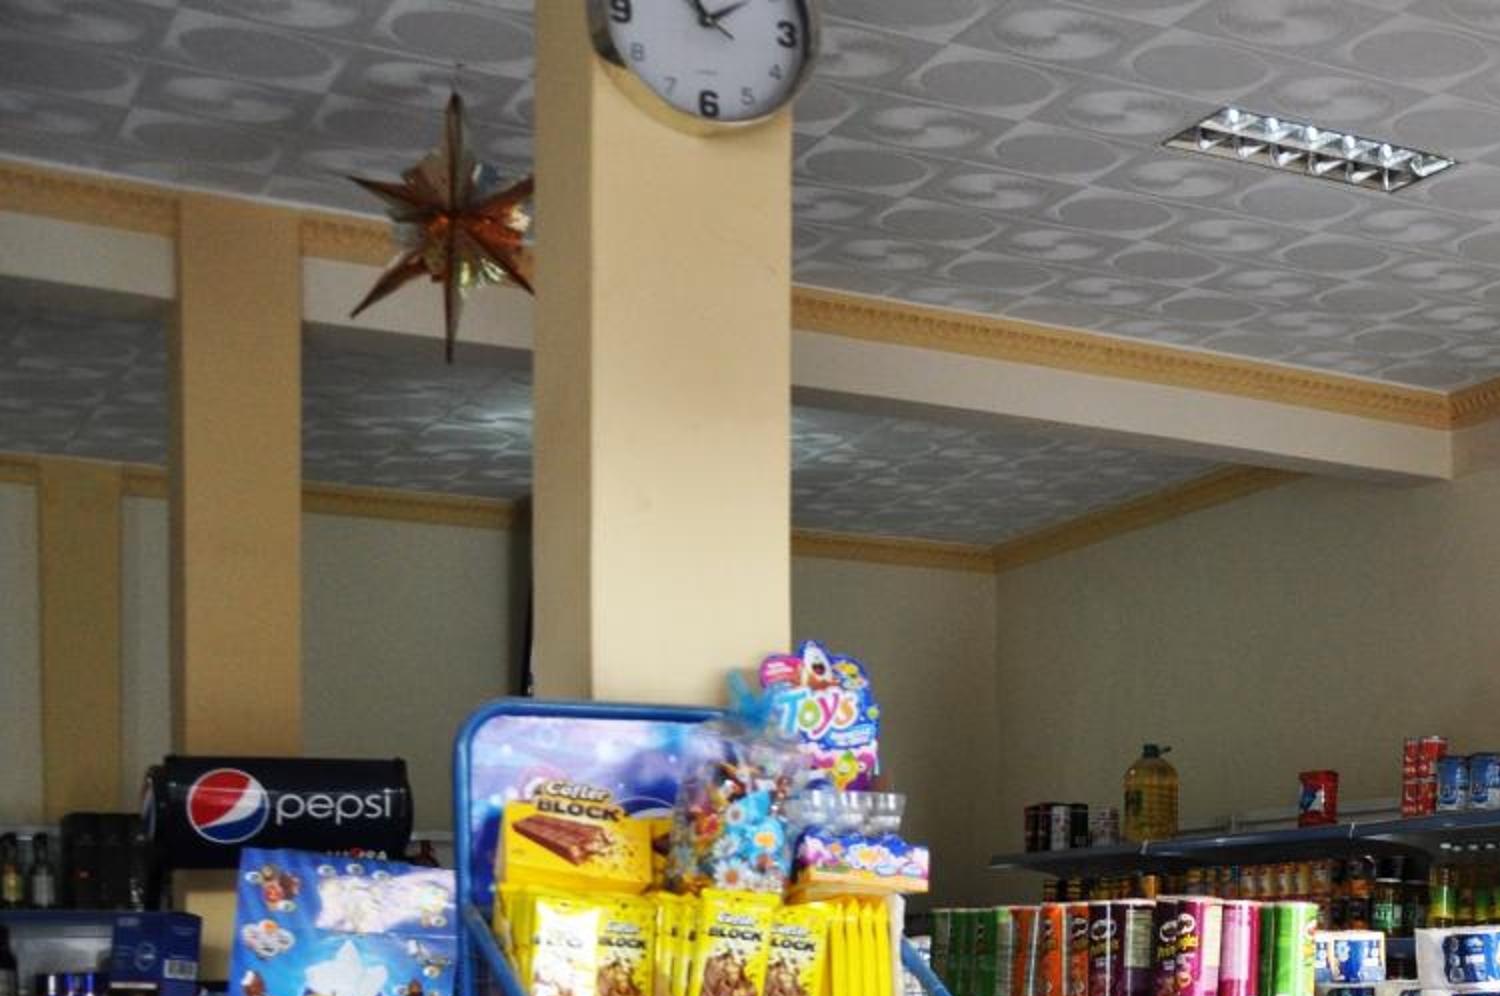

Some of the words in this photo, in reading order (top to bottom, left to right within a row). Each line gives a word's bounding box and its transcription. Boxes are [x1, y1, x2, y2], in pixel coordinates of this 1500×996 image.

[777, 20, 798, 49] 3
[698, 90, 720, 118] 6
[778, 689, 857, 739] Toys
[276, 793, 391, 826] pepsi
